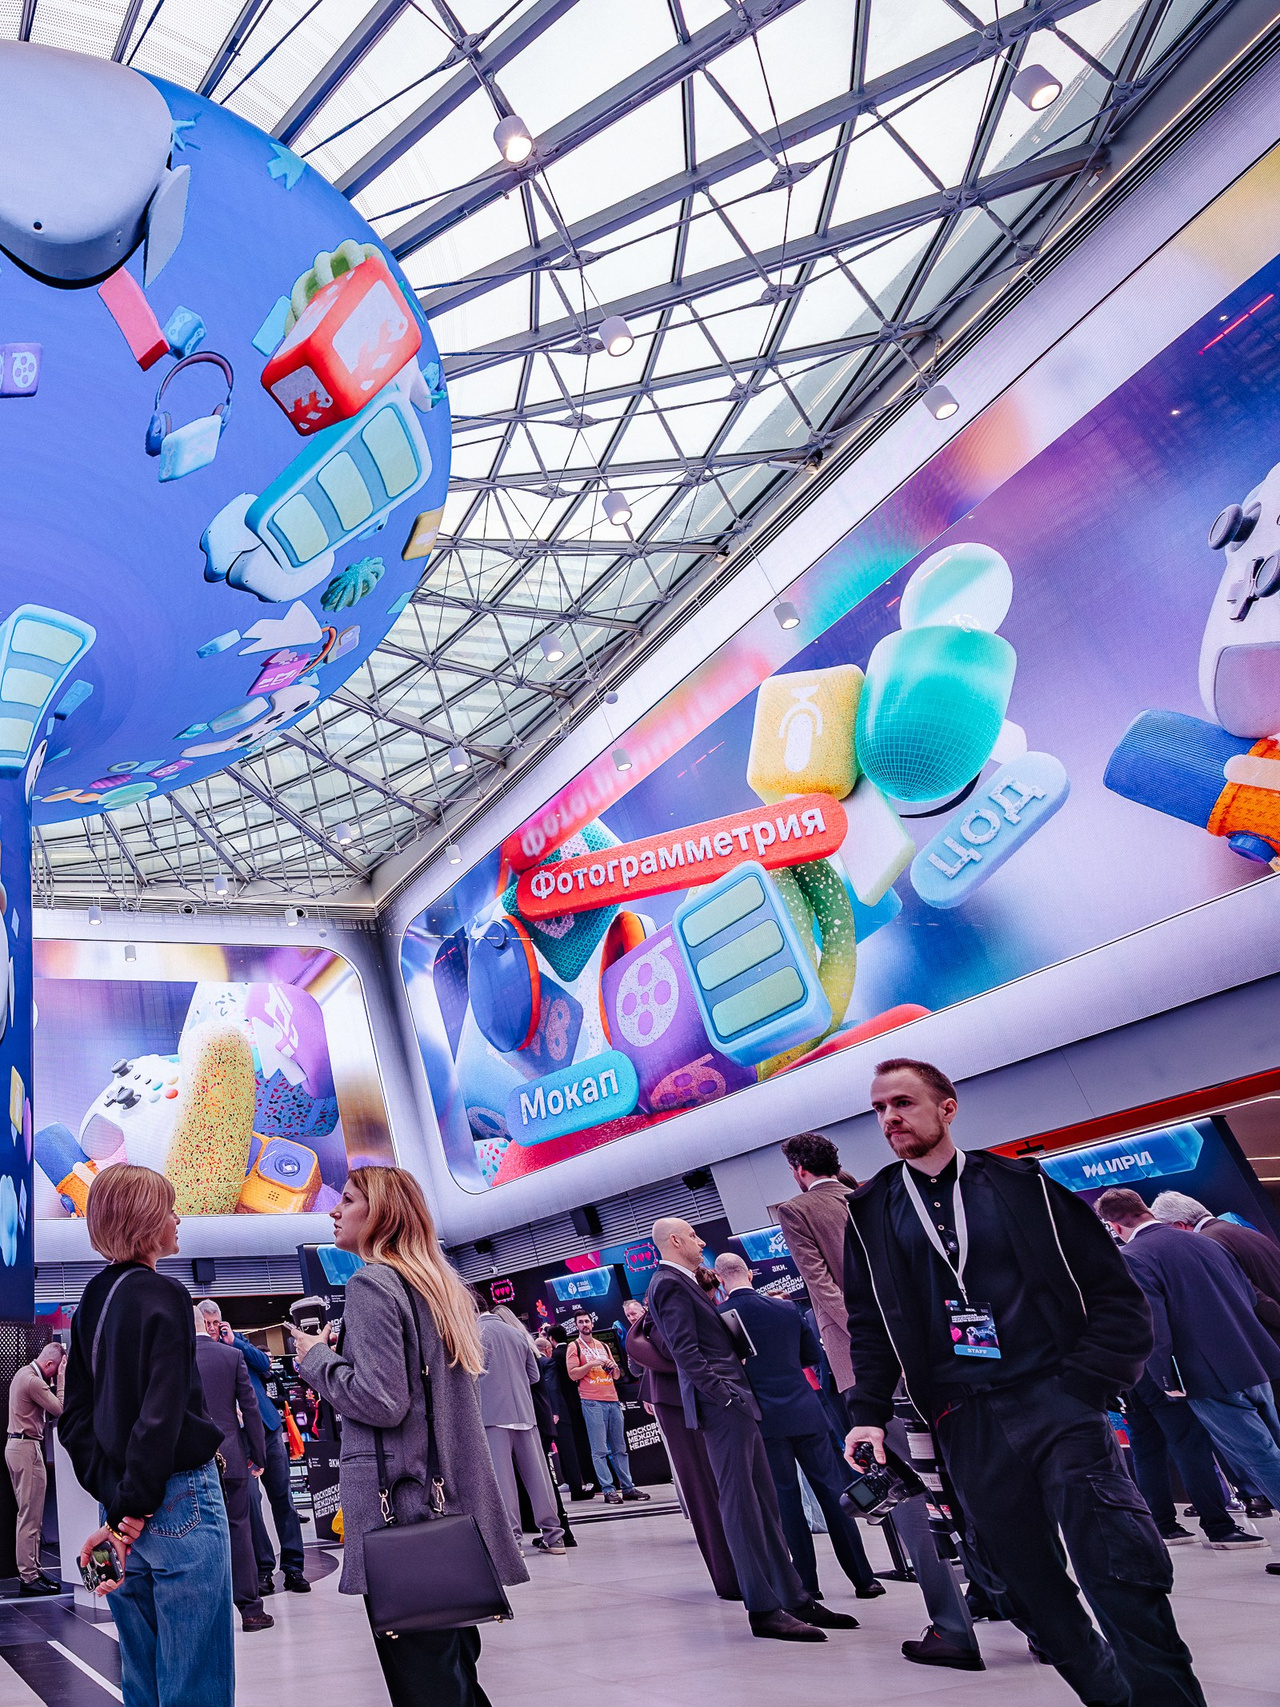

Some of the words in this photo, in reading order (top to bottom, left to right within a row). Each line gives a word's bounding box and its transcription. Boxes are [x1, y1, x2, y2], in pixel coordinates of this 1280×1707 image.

[530, 806, 827, 900] Фотограмметрия
[928, 775, 1047, 880] ЦОД
[519, 1068, 619, 1125] Мокап
[755, 1274, 791, 1295] ОСКОВСКАЯ
[629, 1436, 661, 1451] НЕДЕЛЯ
